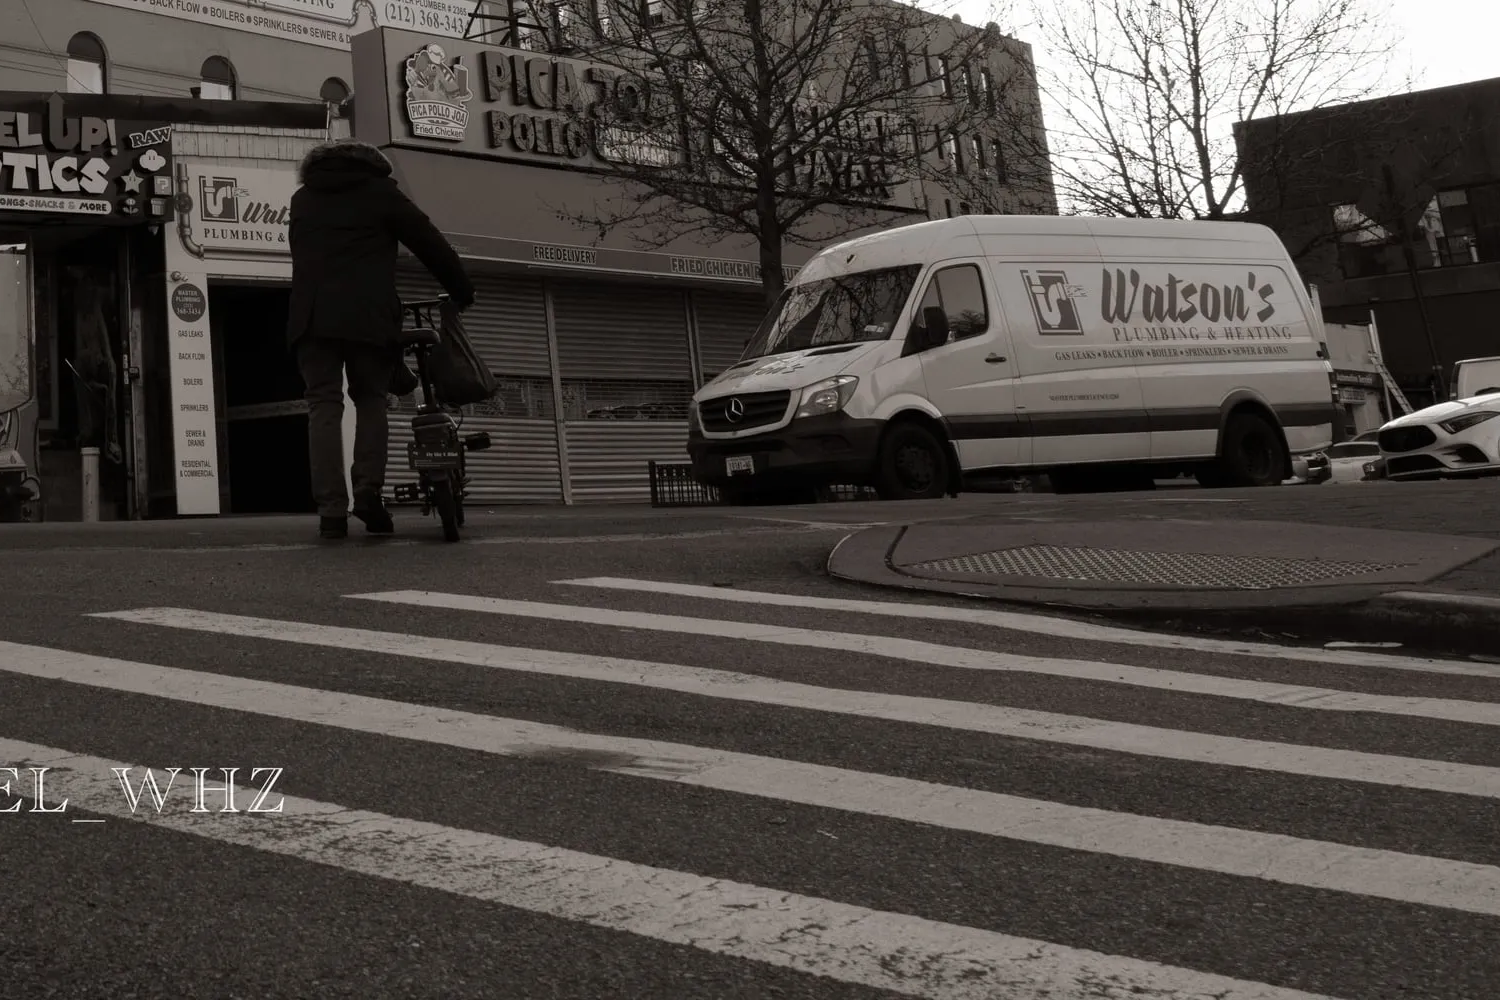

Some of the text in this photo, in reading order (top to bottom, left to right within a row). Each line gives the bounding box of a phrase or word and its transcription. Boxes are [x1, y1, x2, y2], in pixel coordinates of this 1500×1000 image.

[176, 1, 200, 15] FLOW
[210, 8, 245, 23] BOILERS
[253, 15, 302, 35] SPRINKLERS
[310, 27, 337, 42] SEWER
[338, 33, 344, 43] &
[385, 2, 415, 27] (212)
[483, 50, 583, 113] PICA
[411, 102, 468, 126] PICA POLLO JOA
[47, 90, 117, 157] UP!
[415, 124, 464, 139] Fried Chicken
[130, 127, 171, 148] RAW
[488, 110, 589, 159] POLLO
[28, 199, 65, 209] SNACKS
[79, 202, 108, 212] MORE
[204, 228, 286, 242] PLUMBING &
[534, 246, 597, 263] FREE DELIVERY
[672, 257, 702, 274] FRIED
[706, 261, 750, 277] CHICKEN
[1101, 268, 1275, 324] Watson's
[1112, 326, 1292, 342] PLUMBING & HEATING
[1055, 351, 1071, 360] GAS
[1071, 350, 1097, 360] LEAKS
[1103, 350, 1122, 359] BACK
[1123, 349, 1144, 358] FLOW
[1151, 348, 1179, 357] BOILER
[1185, 347, 1228, 356] SPRINKLERS
[1232, 347, 1255, 356] SEWER
[1263, 345, 1288, 354] DRAINS
[183, 378, 203, 386] BOILERS
[180, 404, 208, 412] SPRINKLERS
[184, 470, 215, 478] COMMERCIAL
